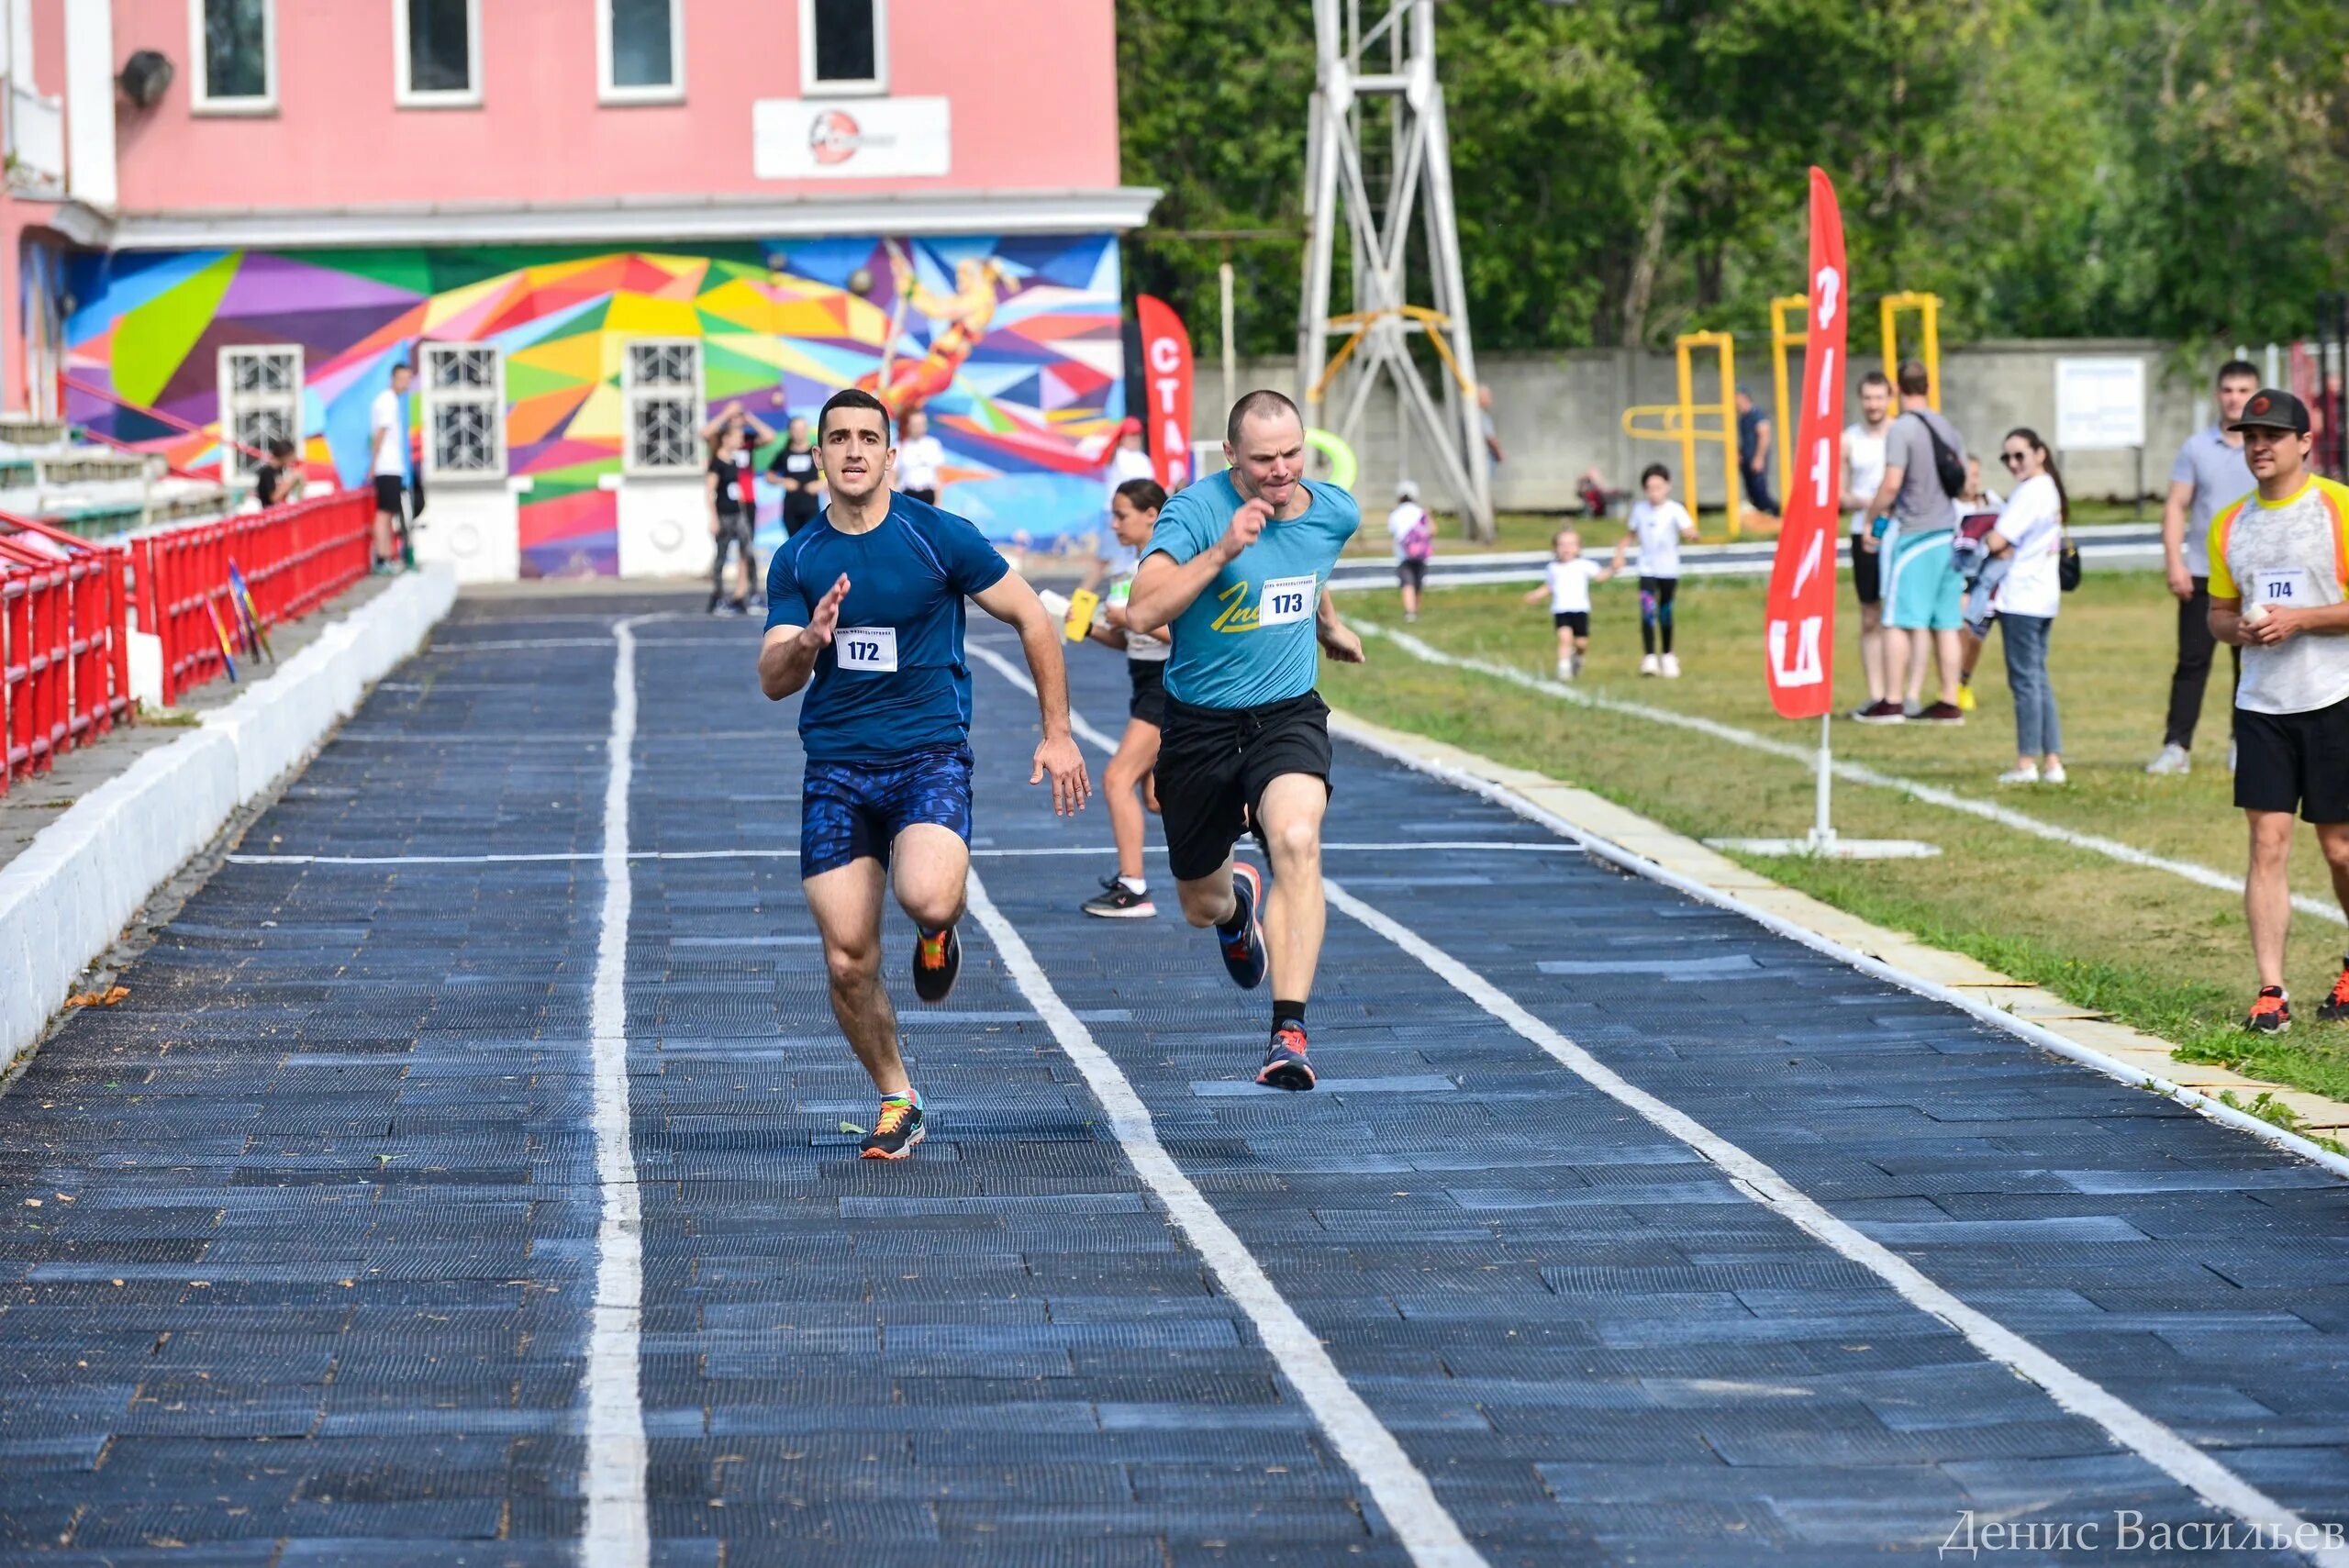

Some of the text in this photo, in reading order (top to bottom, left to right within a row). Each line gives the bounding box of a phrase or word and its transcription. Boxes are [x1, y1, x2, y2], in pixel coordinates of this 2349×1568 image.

[2267, 581, 2292, 598] 174
[1272, 593, 1303, 615] 173
[847, 640, 880, 662] 172
